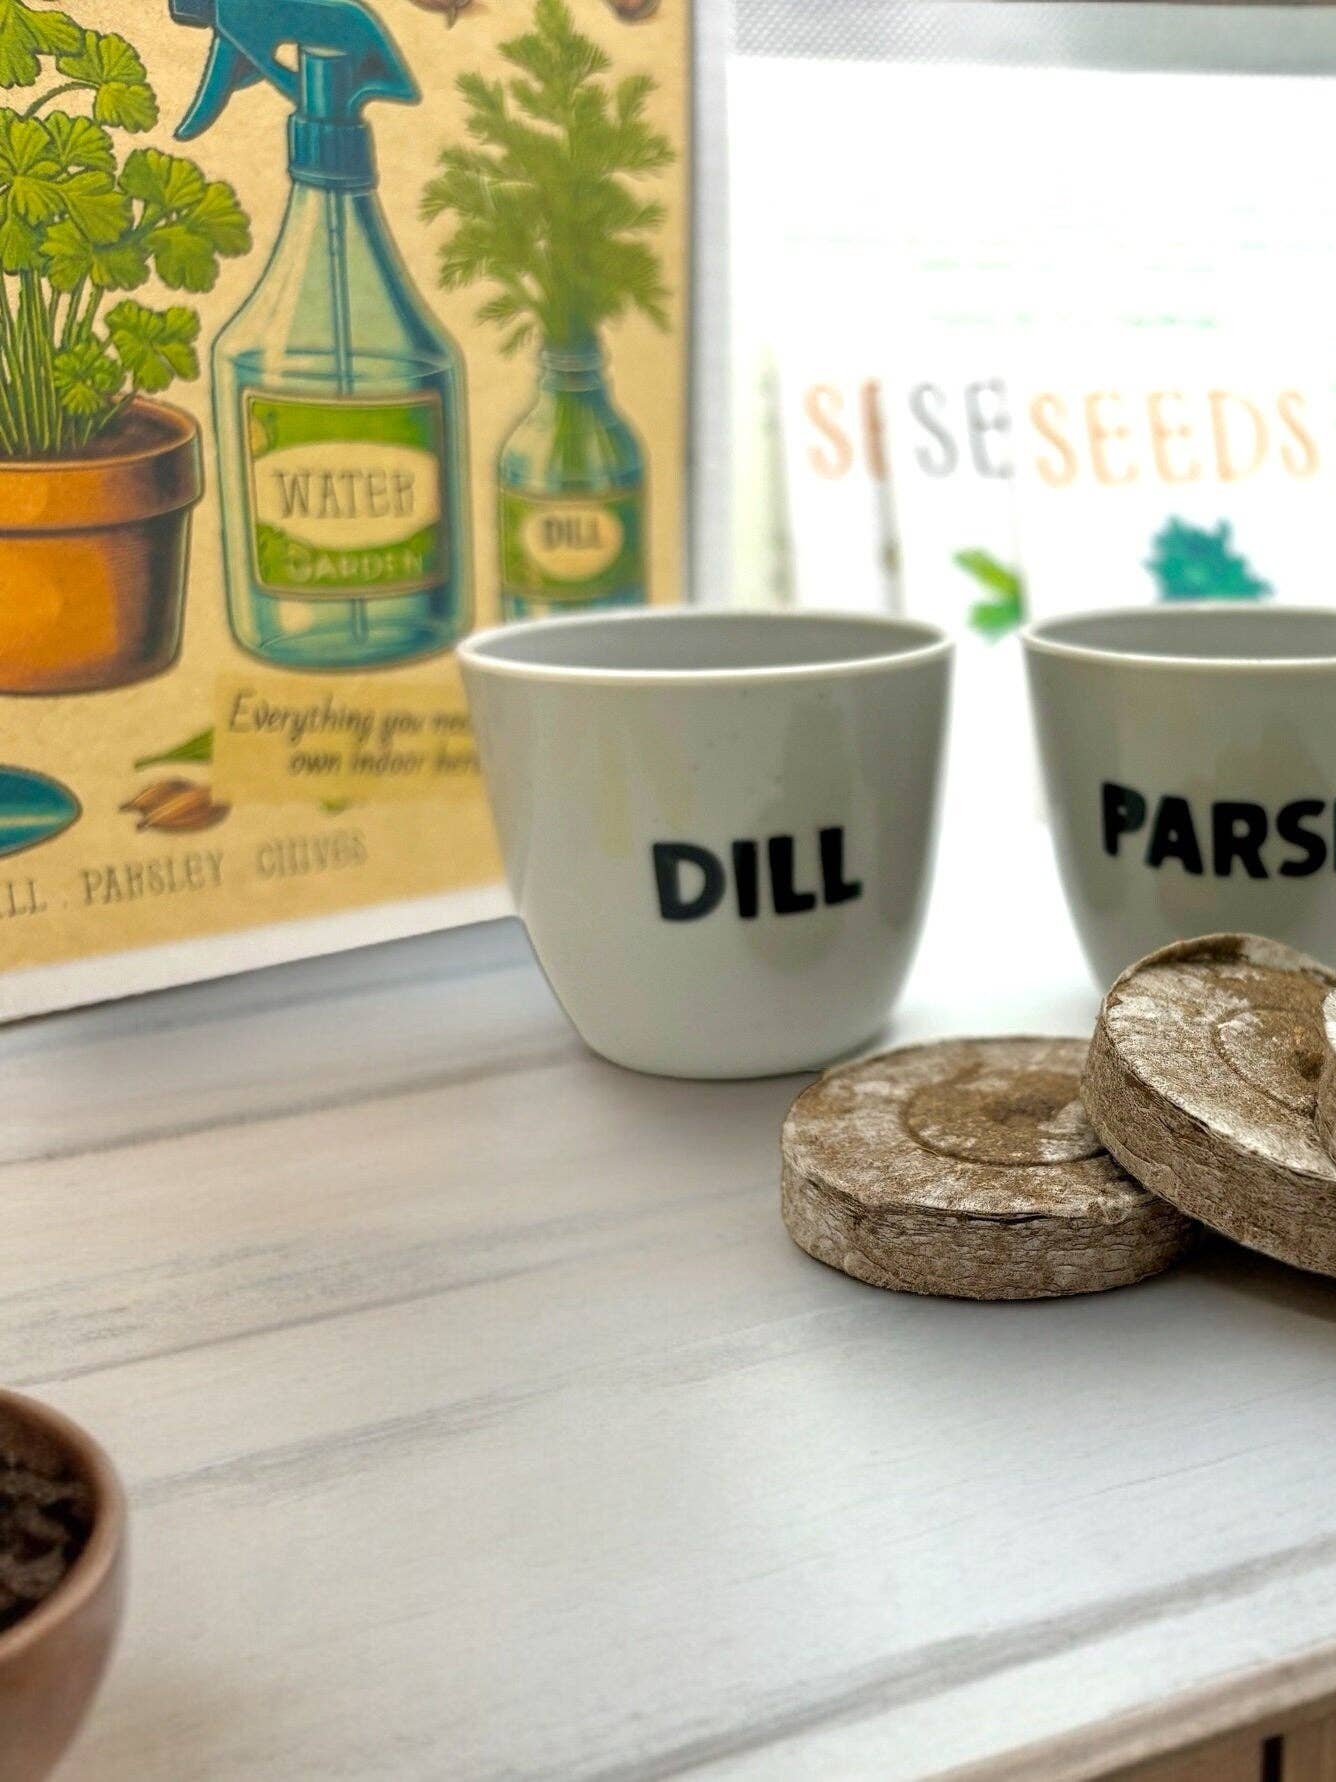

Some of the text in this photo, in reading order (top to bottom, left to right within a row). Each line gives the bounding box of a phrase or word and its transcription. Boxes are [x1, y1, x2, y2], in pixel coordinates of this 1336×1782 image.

[1028, 389, 1323, 488] SEEDS
[540, 514, 602, 550] DILL
[228, 689, 376, 744] Everything
[80, 851, 223, 906] PARSLEY
[653, 827, 862, 922] DILL
